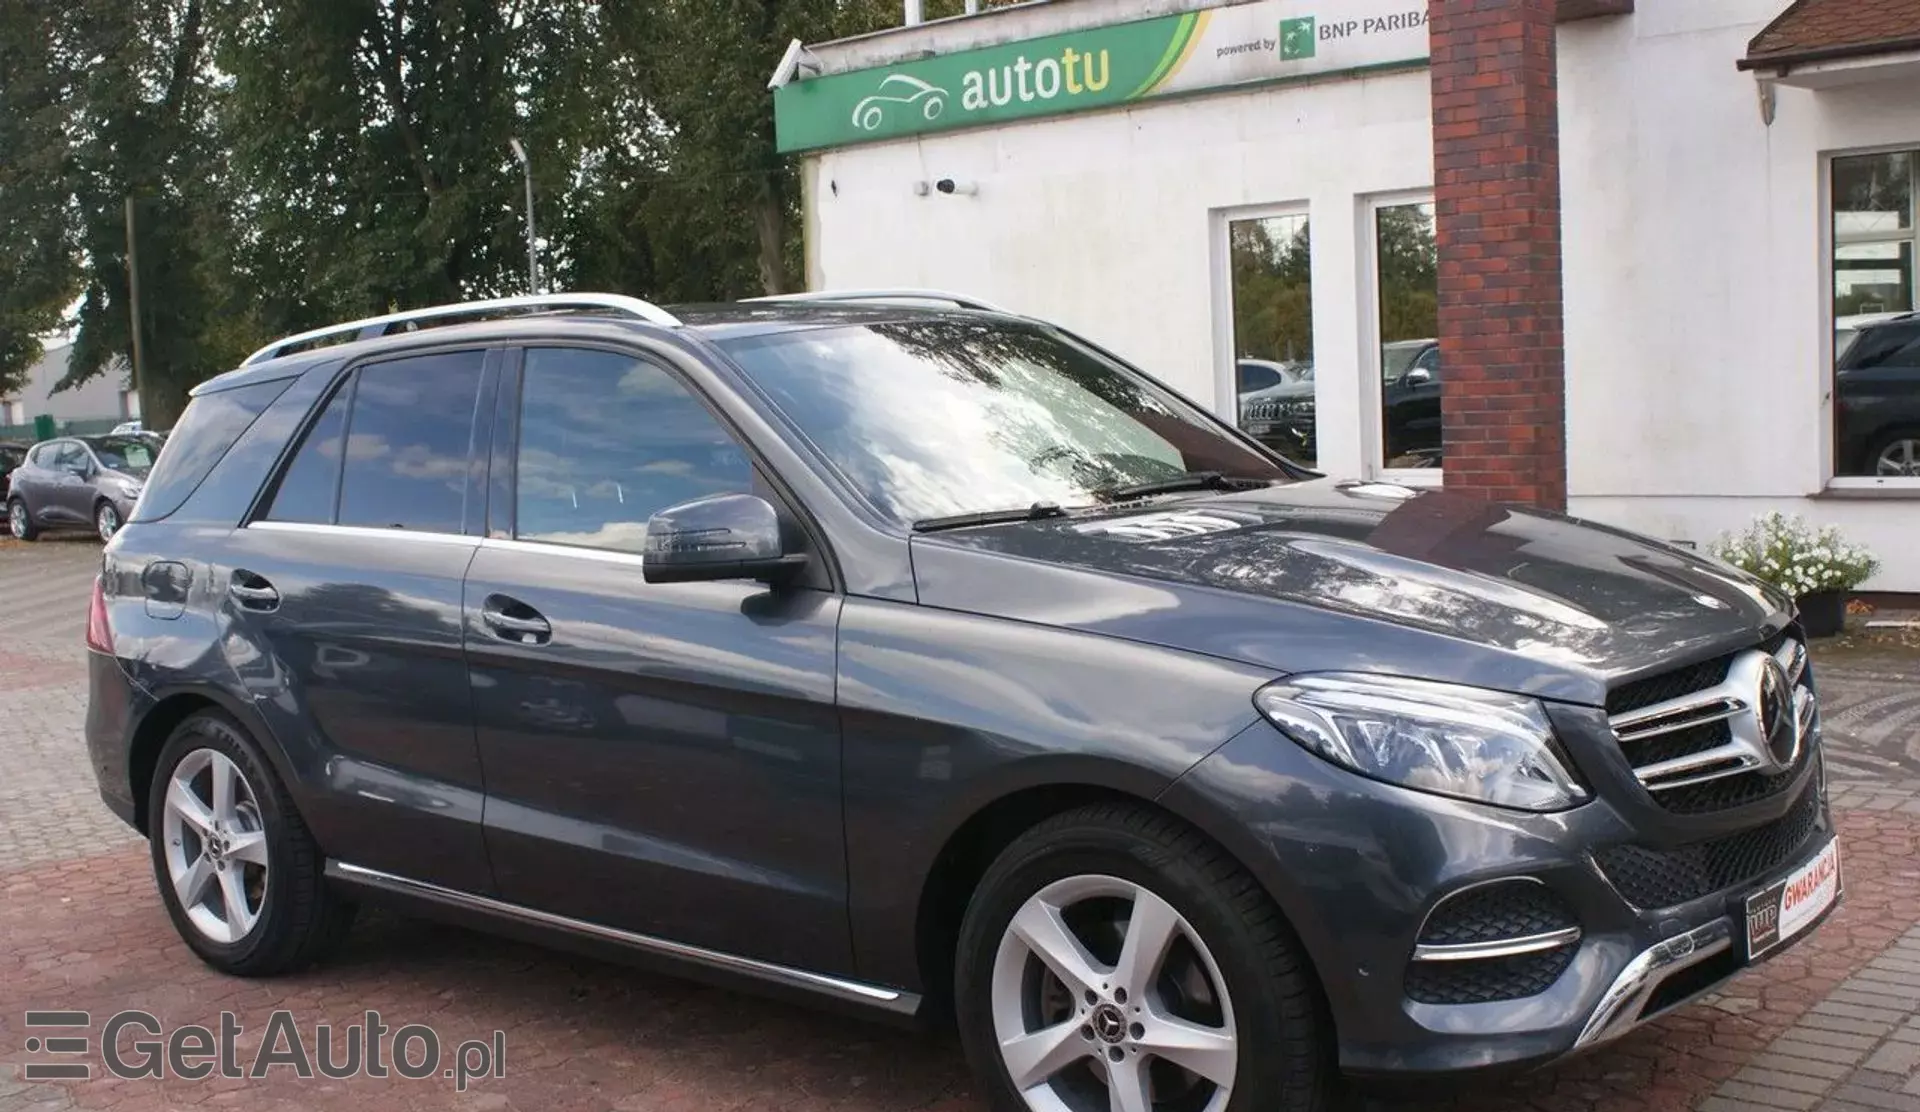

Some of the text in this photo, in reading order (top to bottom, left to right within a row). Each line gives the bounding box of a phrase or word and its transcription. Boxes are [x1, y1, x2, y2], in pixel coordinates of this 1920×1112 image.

[1216, 39, 1260, 59] powered
[1263, 37, 1276, 52] by
[1319, 21, 1358, 41] BNP
[962, 47, 1110, 110] autotu
[1785, 850, 1836, 911] GWARANCJA
